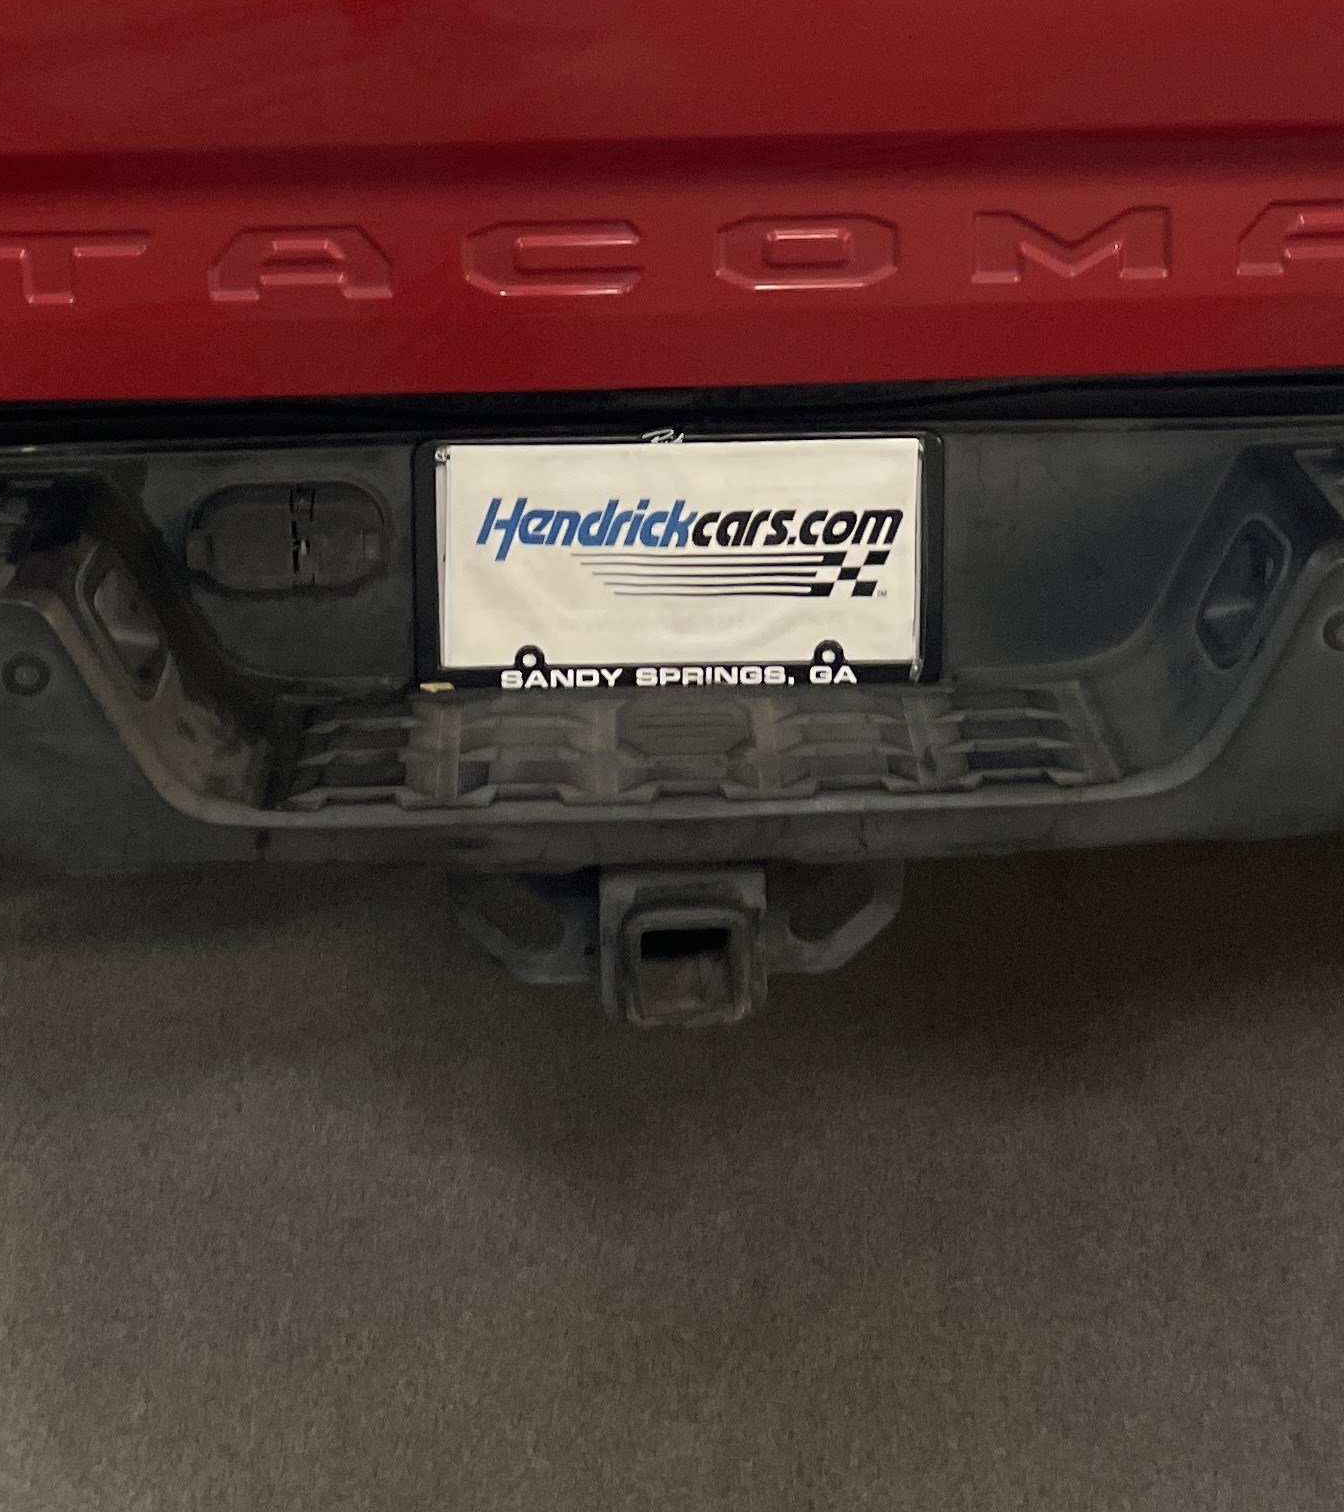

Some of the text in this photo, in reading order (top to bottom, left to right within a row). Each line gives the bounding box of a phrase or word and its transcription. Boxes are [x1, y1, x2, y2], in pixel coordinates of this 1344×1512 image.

[476, 496, 904, 561] Hendrickcars.com
[501, 665, 858, 689] SANDY SPRINGS, GA
